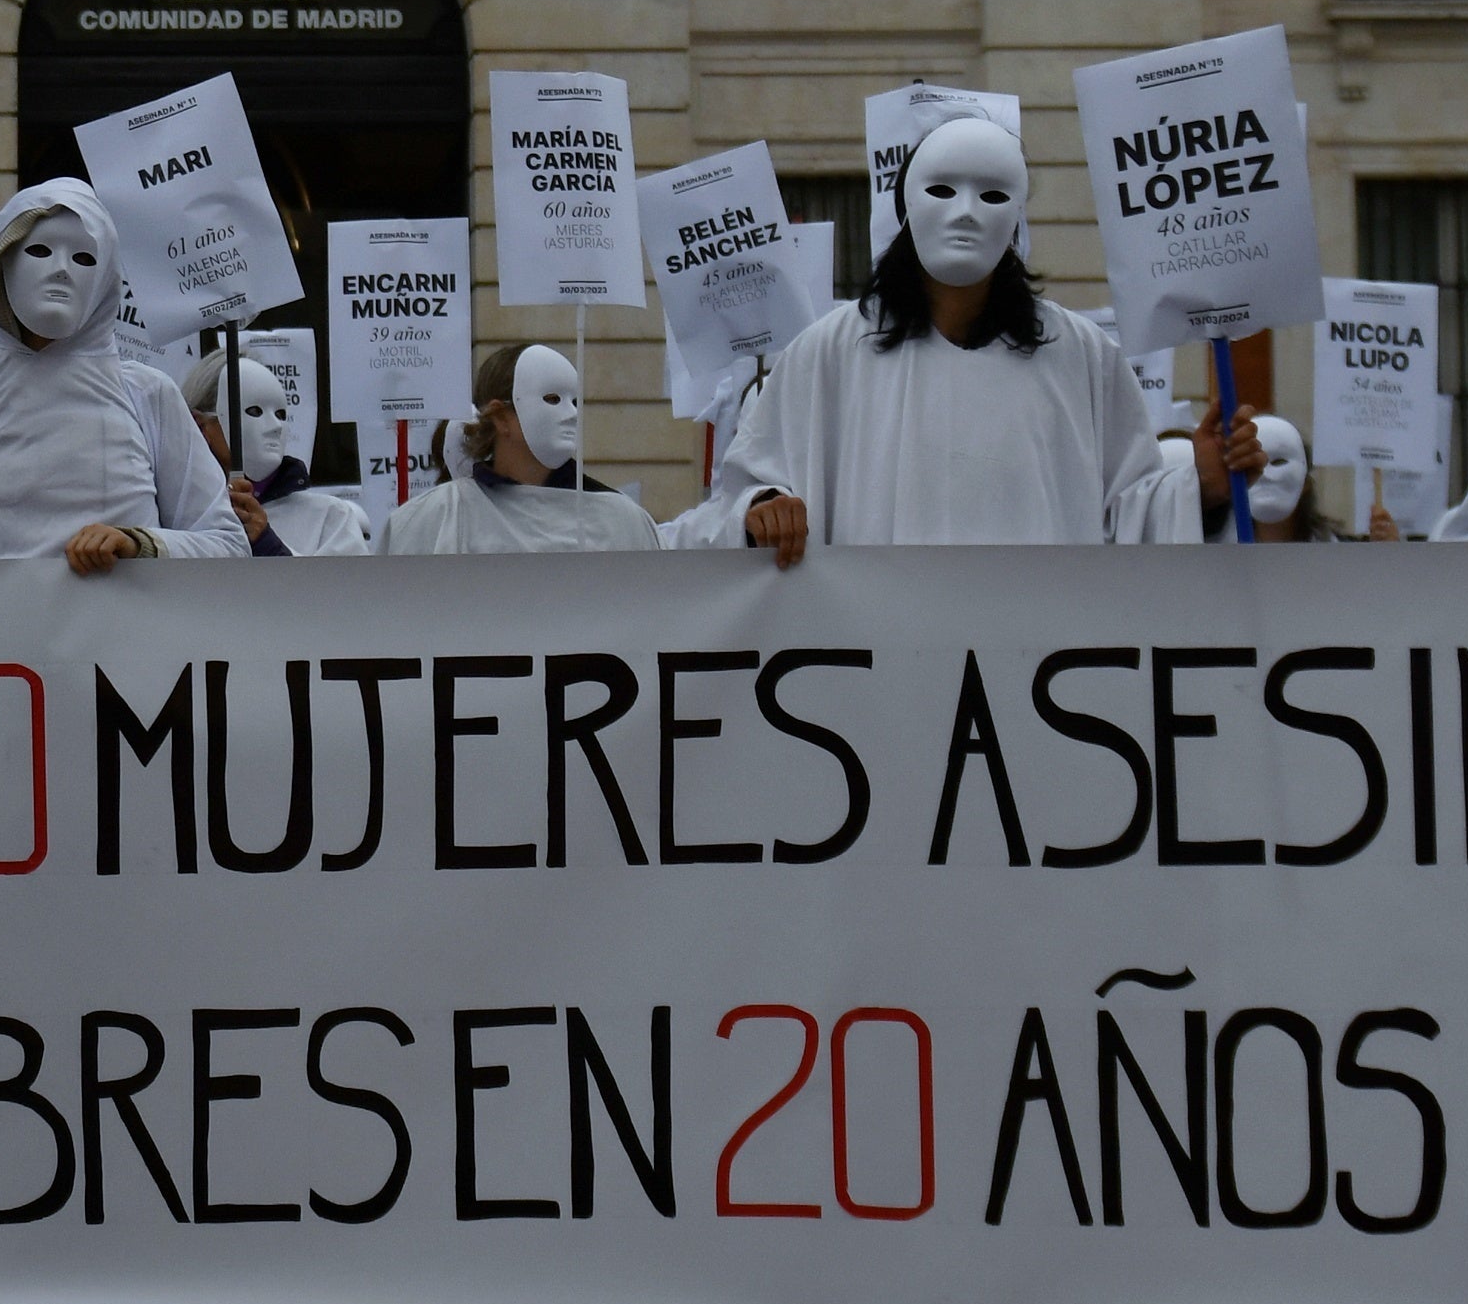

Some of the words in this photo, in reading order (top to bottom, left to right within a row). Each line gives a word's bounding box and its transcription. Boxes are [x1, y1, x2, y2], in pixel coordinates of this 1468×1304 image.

[79, 8, 243, 30] COMUNIDAD
[252, 8, 289, 29] DE
[296, 8, 403, 30] MADRID
[1134, 63, 1198, 84] ASESINADA
[537, 87, 585, 96] ASESINADA
[127, 104, 176, 128] ASESINADA
[511, 125, 589, 149] MARÍA
[592, 131, 623, 152] DEL
[1112, 108, 1270, 172] NÚRIA
[137, 145, 213, 191] MARI
[525, 152, 618, 172] CARMEN
[531, 170, 617, 193] GARCÍA
[671, 173, 713, 191] ASESINADA
[1116, 153, 1280, 219] LÓPEZ
[543, 201, 566, 219] 60
[571, 200, 611, 219] años
[1156, 212, 1185, 238] 48
[1194, 206, 1251, 232] años
[369, 232, 410, 240] ASESINADA
[555, 224, 603, 236] MIERES
[677, 206, 756, 247] BELÉN
[166, 236, 186, 260] 61
[195, 224, 235, 250] años
[665, 222, 782, 276] SÁNCHEZ
[1167, 230, 1247, 258] CATLLAR
[176, 246, 241, 279] VALENCIA
[702, 269, 721, 289] 45
[726, 260, 765, 282] años
[1151, 242, 1270, 280] (TARRAGONA)
[178, 259, 248, 295] (VALENCIA)
[342, 272, 457, 295] ENCARNI
[351, 293, 449, 320] MUÑOZ
[369, 327, 390, 343] 39
[394, 326, 433, 342] años
[1330, 321, 1425, 348] NICOLA
[369, 356, 434, 370] (GRANADA)
[378, 346, 424, 357] MOTRIL
[1345, 347, 1410, 372] LUPO
[94, 650, 874, 877] MUJERES
[453, 1003, 678, 1222] EN
[714, 1002, 937, 1222] 20
[984, 963, 1448, 1235] AÑOS
